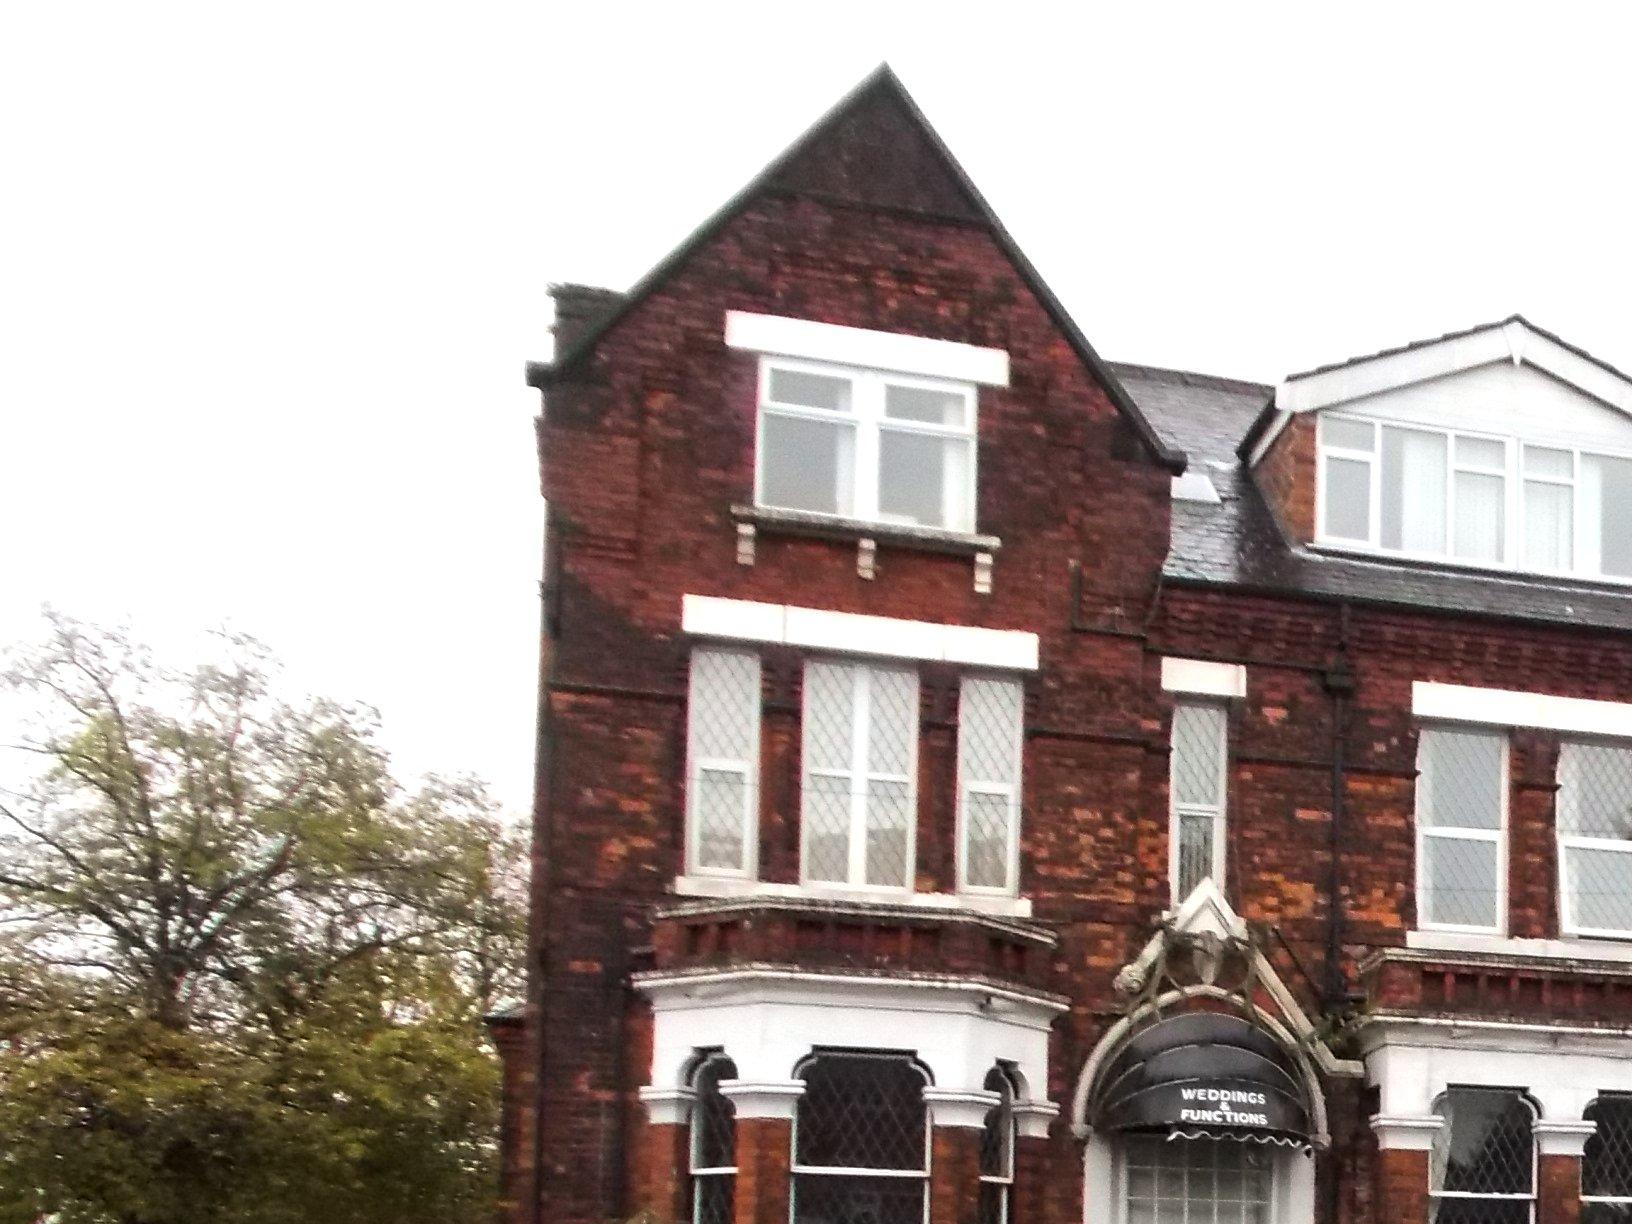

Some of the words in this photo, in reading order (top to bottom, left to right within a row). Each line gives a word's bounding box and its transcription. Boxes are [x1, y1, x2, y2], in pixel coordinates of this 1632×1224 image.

[1181, 1088, 1266, 1105] WEDDINGS
[1219, 1101, 1231, 1111] &
[1181, 1109, 1268, 1125] FUNCTIONS
